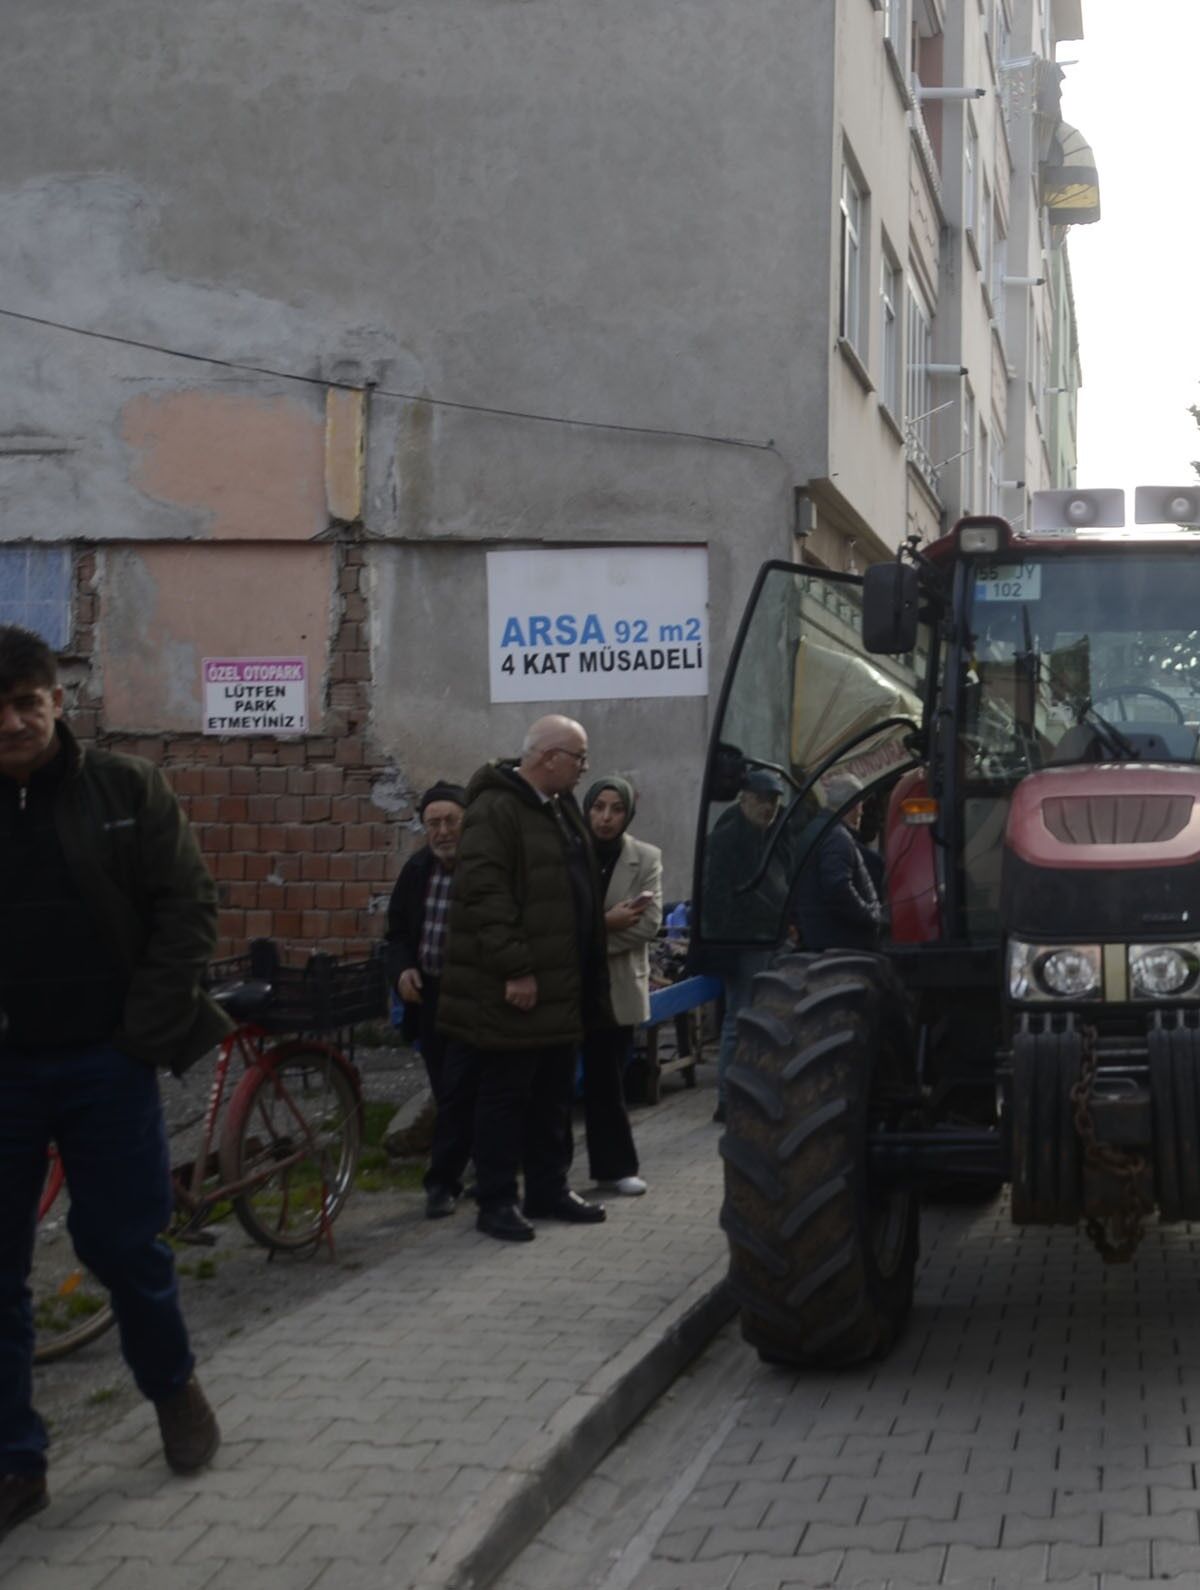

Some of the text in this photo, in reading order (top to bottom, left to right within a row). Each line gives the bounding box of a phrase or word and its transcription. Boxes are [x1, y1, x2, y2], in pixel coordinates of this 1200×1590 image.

[993, 582, 1023, 597] 102
[500, 614, 702, 647] ARSA 92 m2
[501, 642, 703, 675] 4 KAT MÜSADELİ
[208, 662, 301, 681] ÖZEL OTOPARK
[224, 684, 286, 698] LÜTFEN
[234, 699, 277, 712] PARK
[207, 713, 295, 729] ETMEYİNİZ
